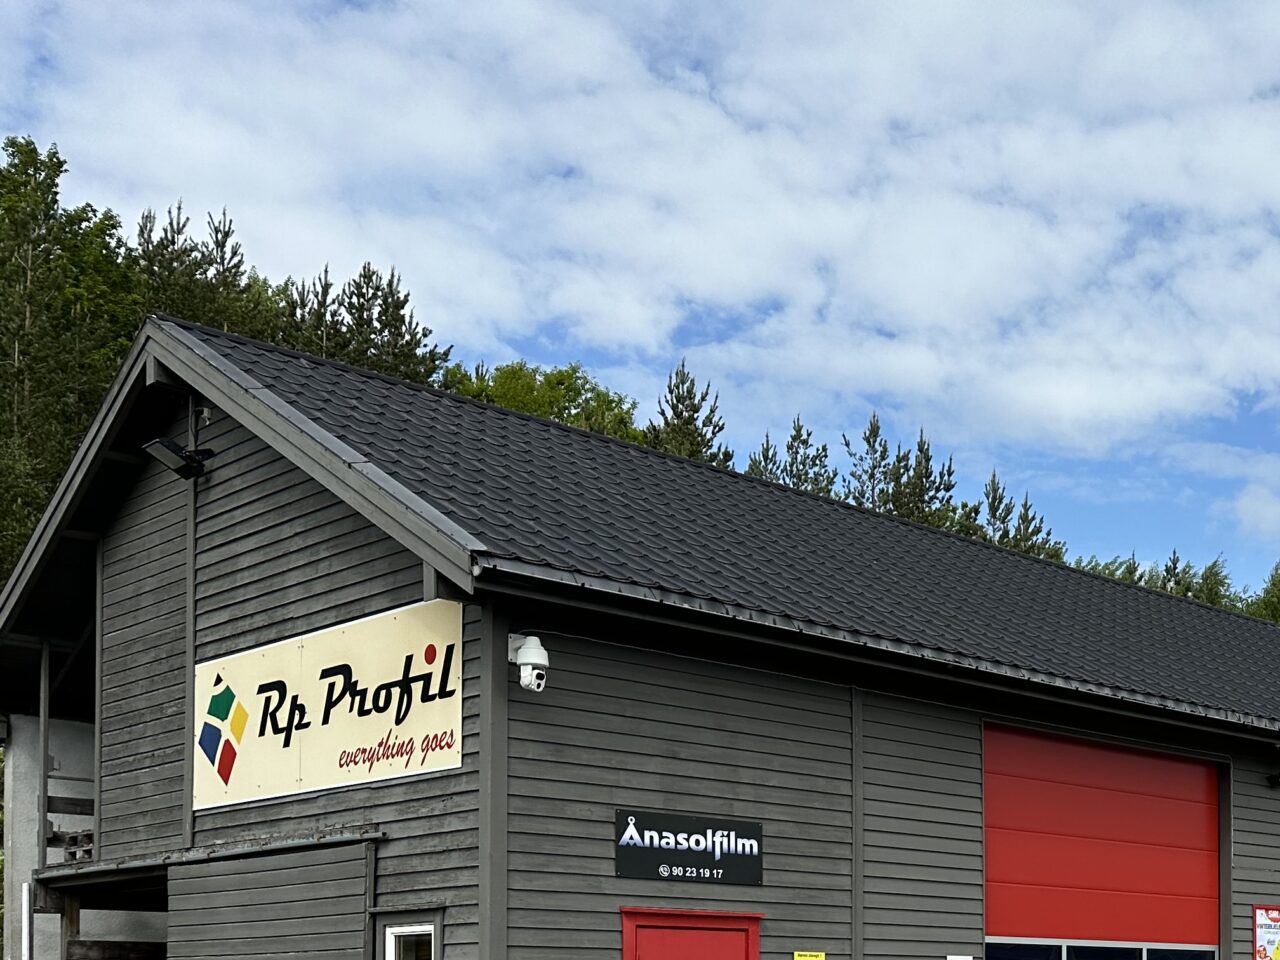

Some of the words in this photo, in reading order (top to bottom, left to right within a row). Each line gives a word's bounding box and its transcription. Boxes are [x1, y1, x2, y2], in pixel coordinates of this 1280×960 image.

[256, 680, 312, 748] Rp
[318, 643, 456, 726] Profil
[338, 729, 416, 773] everything
[420, 728, 456, 766] goes
[618, 816, 759, 861] Ånasolfilm
[671, 866, 683, 876] 90
[685, 867, 697, 877] 23
[699, 868, 710, 878] 19
[712, 869, 723, 879] 17
